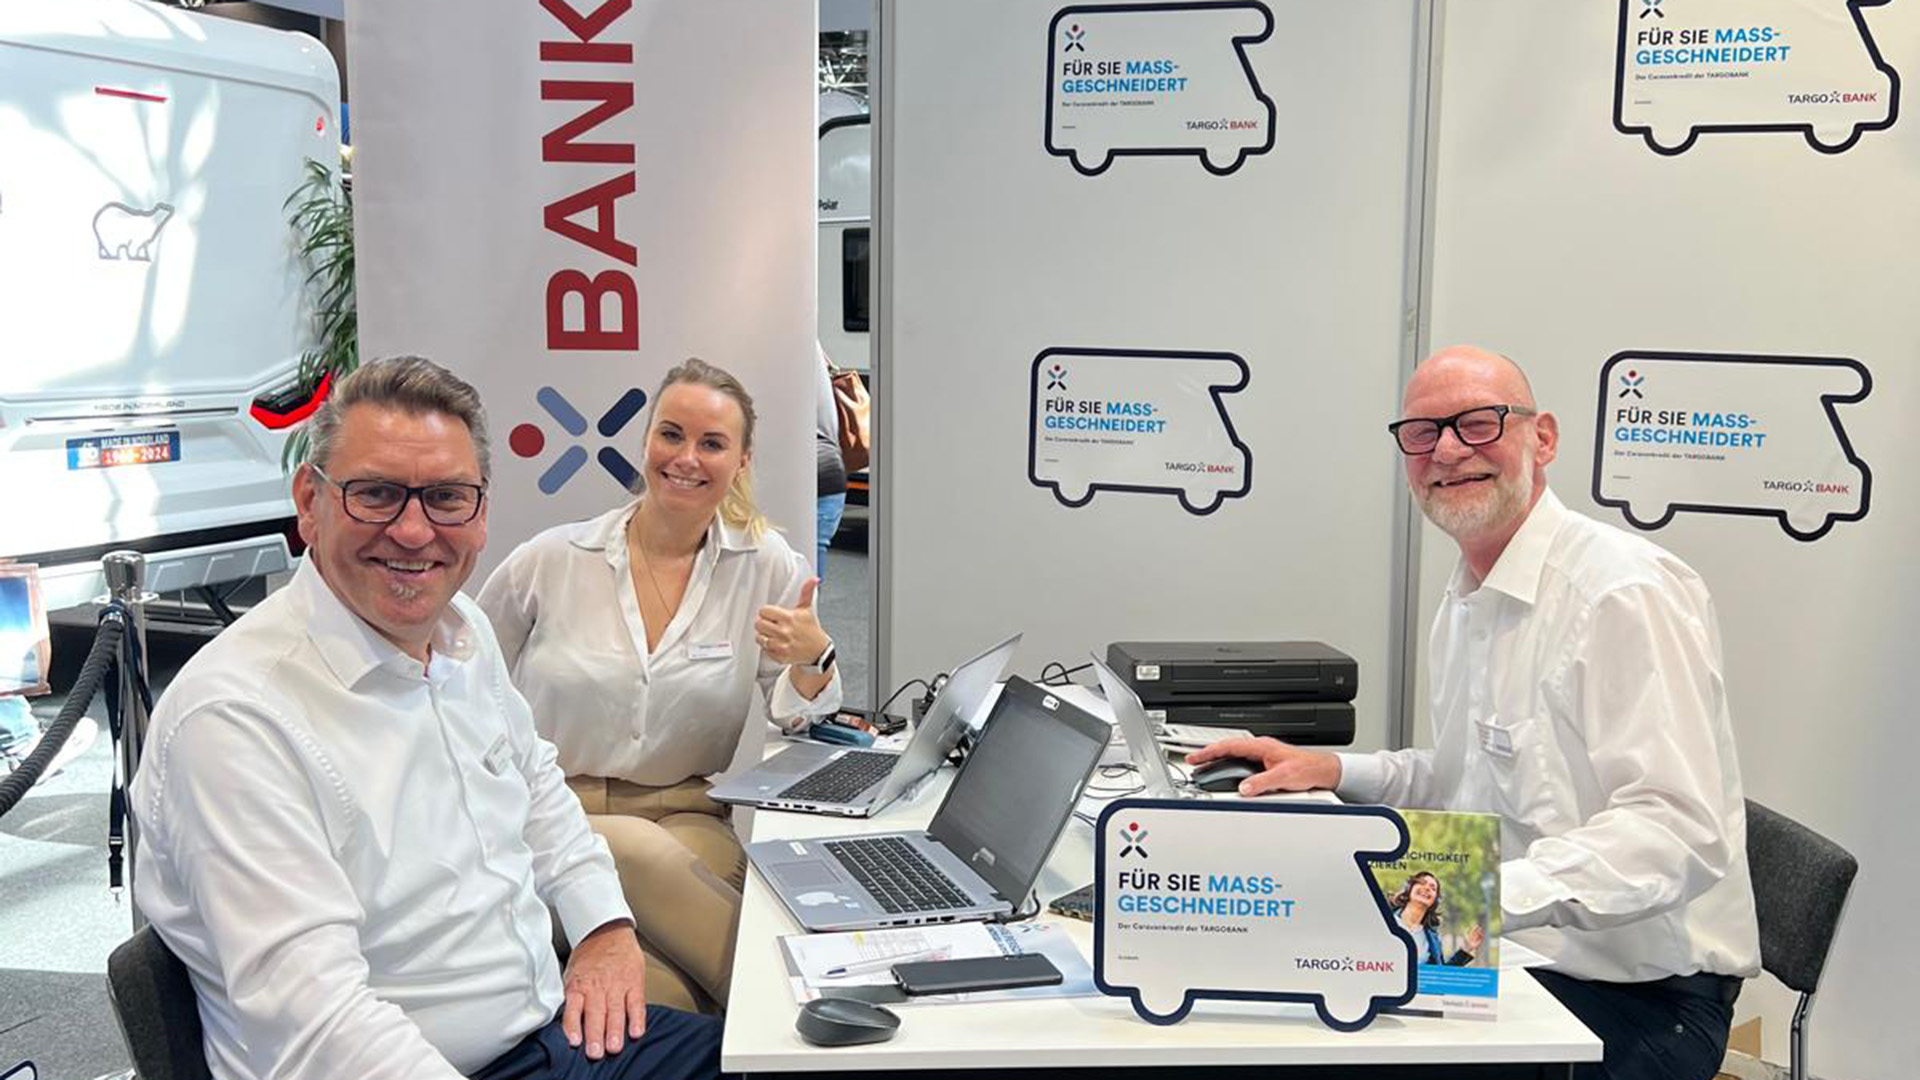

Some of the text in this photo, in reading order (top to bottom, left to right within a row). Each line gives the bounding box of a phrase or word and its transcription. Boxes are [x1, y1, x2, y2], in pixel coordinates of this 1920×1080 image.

[1637, 27, 1781, 46] FÜR SIE MASS-
[1636, 46, 1791, 65] GESCHNEIDERT
[1063, 59, 1179, 76] FÜR SIE MASS-
[1062, 77, 1188, 93] GESCHNEIDERT
[539, 0, 640, 350] BANK
[1046, 396, 1158, 416] FÜR SIE MASS-
[1045, 415, 1166, 433] GESCHNEIDERT
[1616, 406, 1757, 428] FÜR SIE MASS-
[1615, 427, 1766, 448] GESCHNEIDERT
[1119, 868, 1282, 894] FÜR SIE MASS-
[1118, 895, 1295, 917] GESCHNEIDERT
[1200, 925, 1248, 933] TARGOBANK
